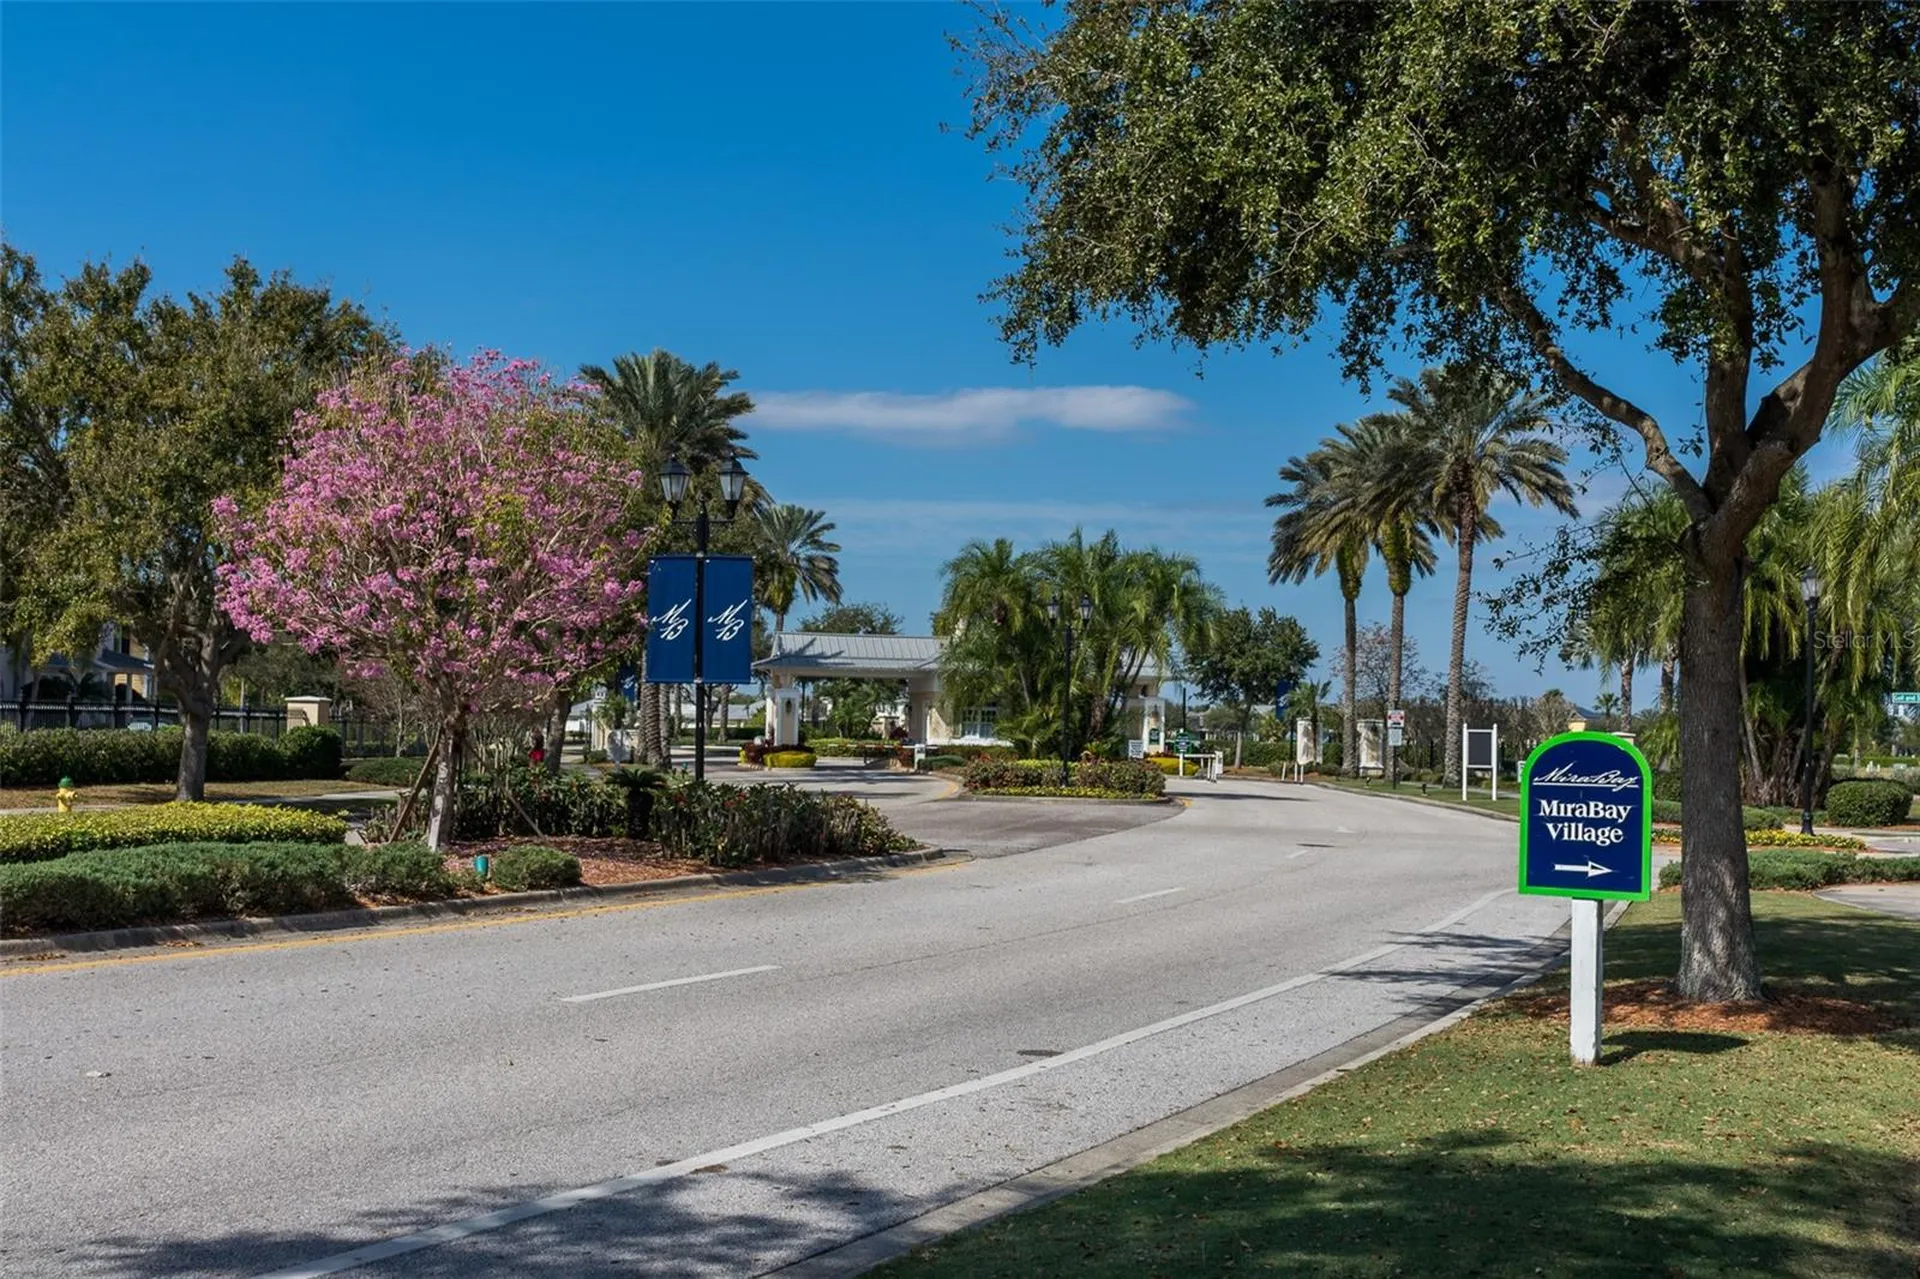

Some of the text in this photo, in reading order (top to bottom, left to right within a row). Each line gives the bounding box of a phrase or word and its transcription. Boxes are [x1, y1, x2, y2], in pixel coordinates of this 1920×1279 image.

[1533, 760, 1639, 792] MiraBay
[1538, 799, 1632, 823] MiraBay
[1546, 822, 1624, 846] Village
